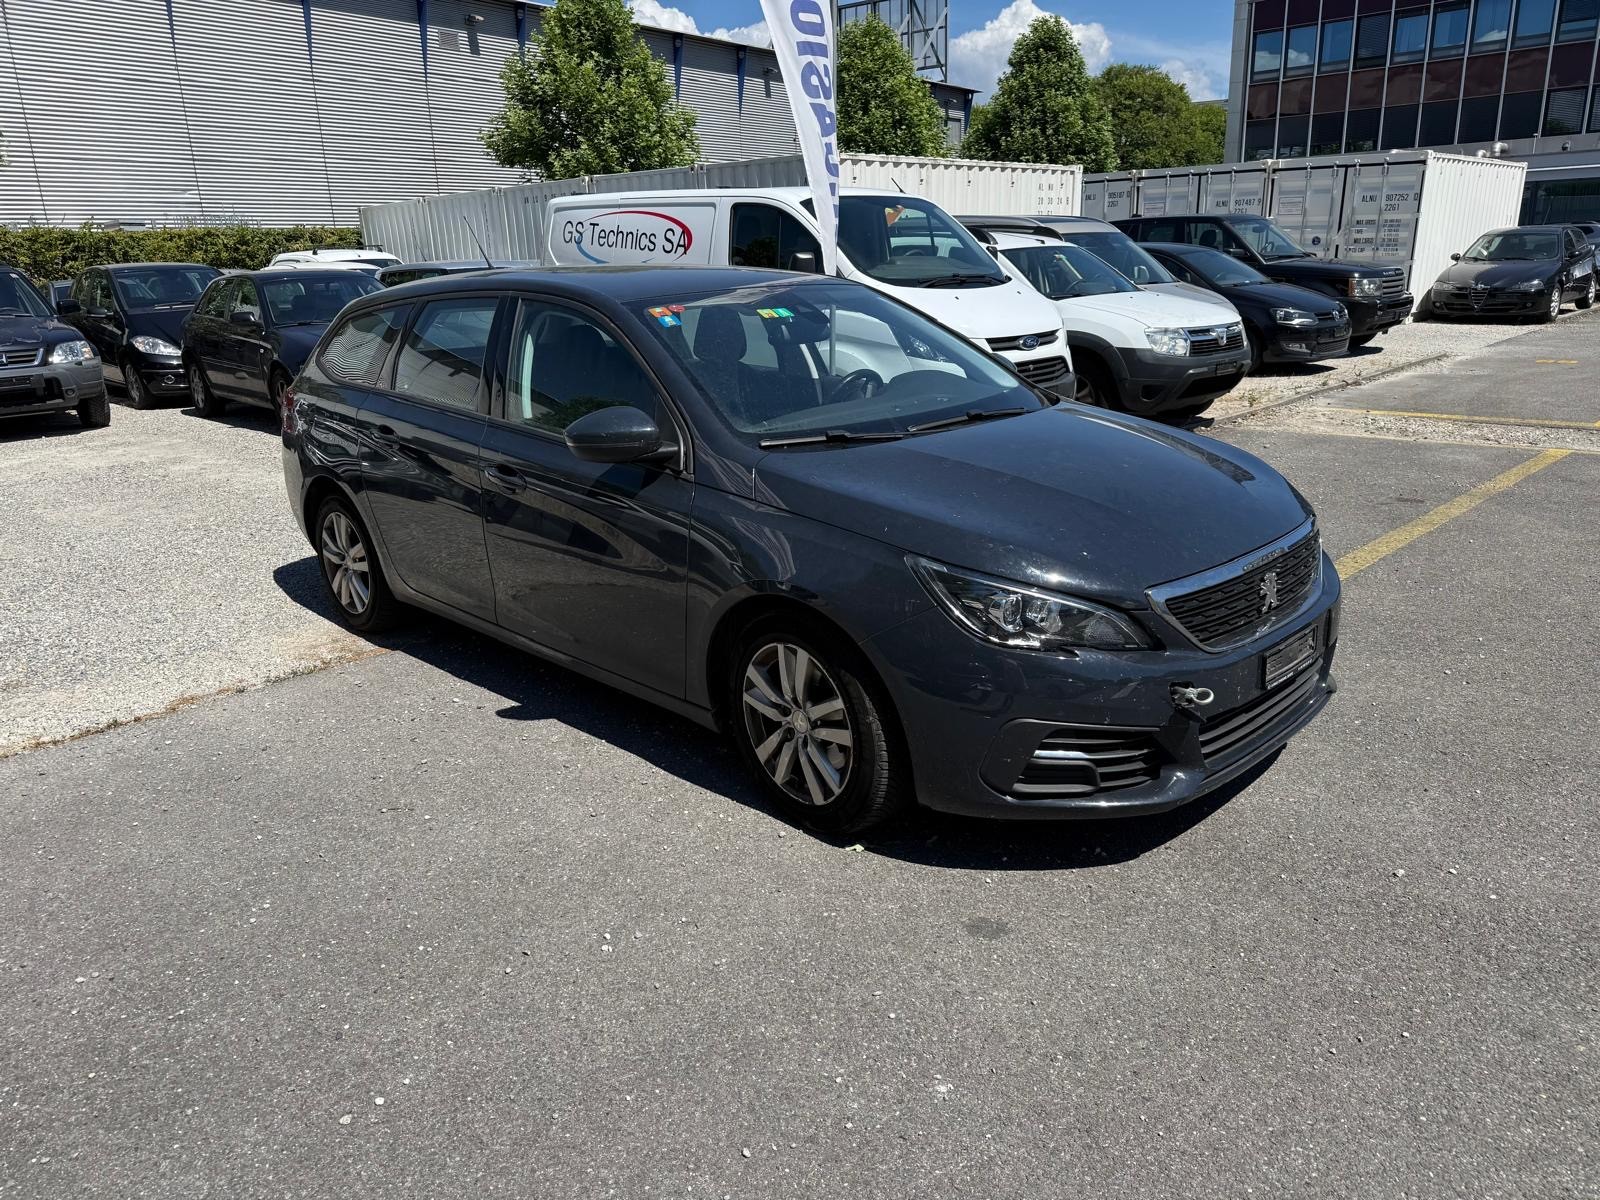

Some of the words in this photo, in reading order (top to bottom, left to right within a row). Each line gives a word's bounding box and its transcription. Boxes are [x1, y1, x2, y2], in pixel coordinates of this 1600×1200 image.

[1361, 194, 1377, 203] ALNU
[1385, 193, 1409, 202] 907252
[562, 220, 585, 245] GS
[588, 222, 657, 252] Technics
[662, 227, 688, 256] SA
